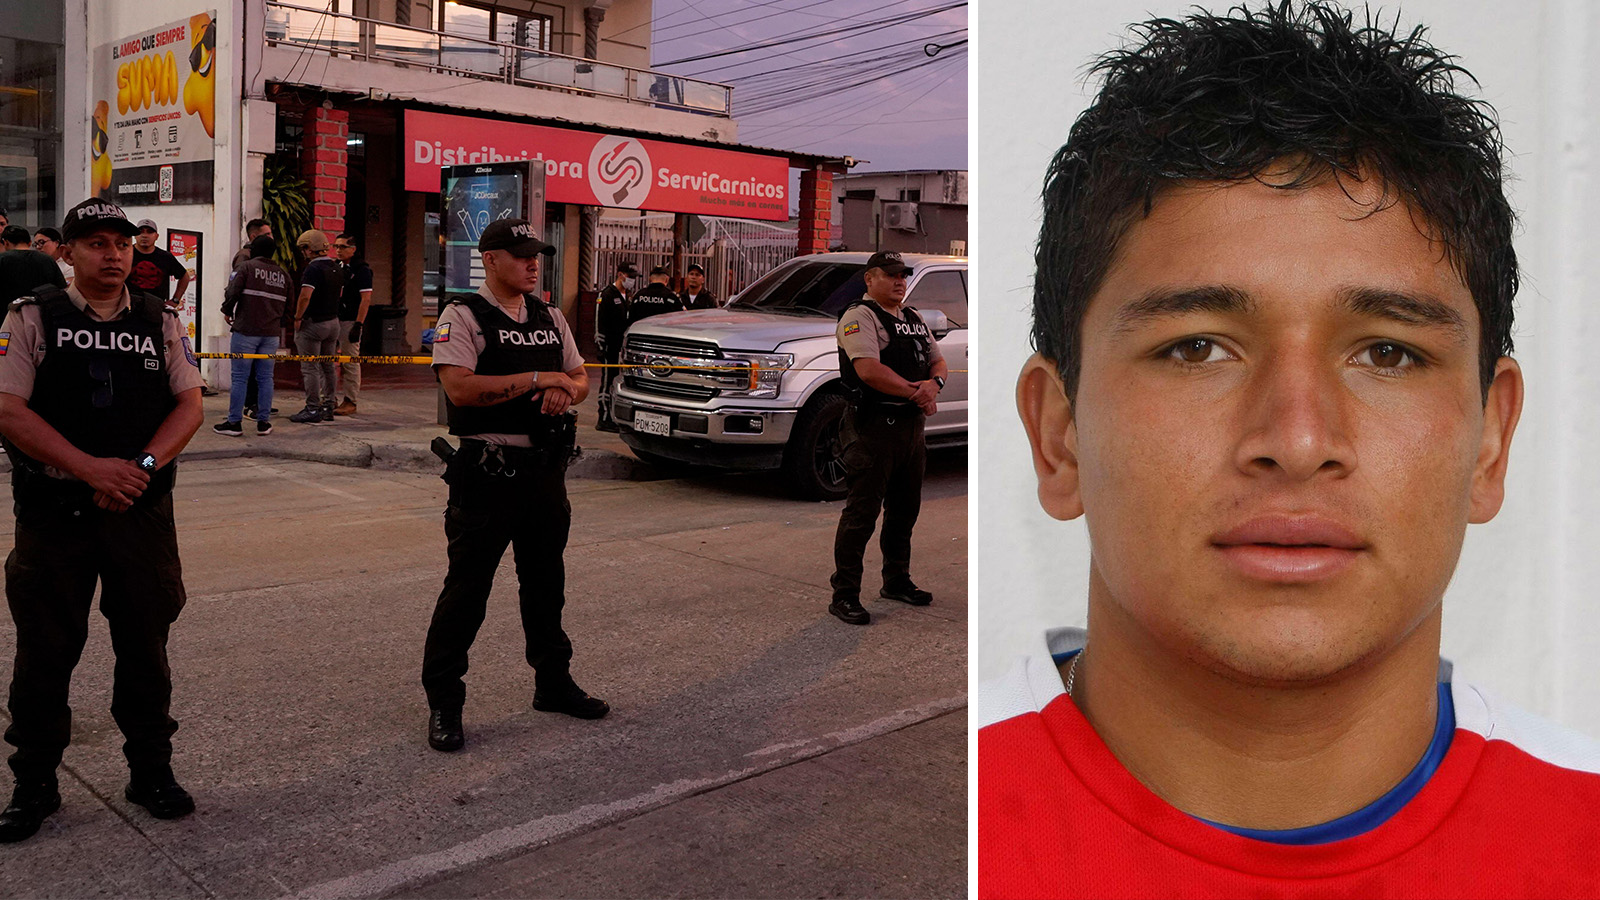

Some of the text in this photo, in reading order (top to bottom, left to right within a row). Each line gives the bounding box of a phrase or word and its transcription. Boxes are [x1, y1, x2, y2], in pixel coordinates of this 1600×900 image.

[113, 26, 185, 59] EL AMIGO QUE SIEMPRE
[117, 50, 178, 116] SUMA
[657, 167, 784, 199] ServiCarnicos
[474, 192, 499, 200] JCDecaux
[700, 195, 727, 206] Mucho
[759, 202, 783, 210] carnes
[639, 295, 665, 304] POLICIA
[498, 329, 560, 346] POLICIA
[895, 323, 928, 336] POLICIA
[57, 328, 157, 356] POLICIA
